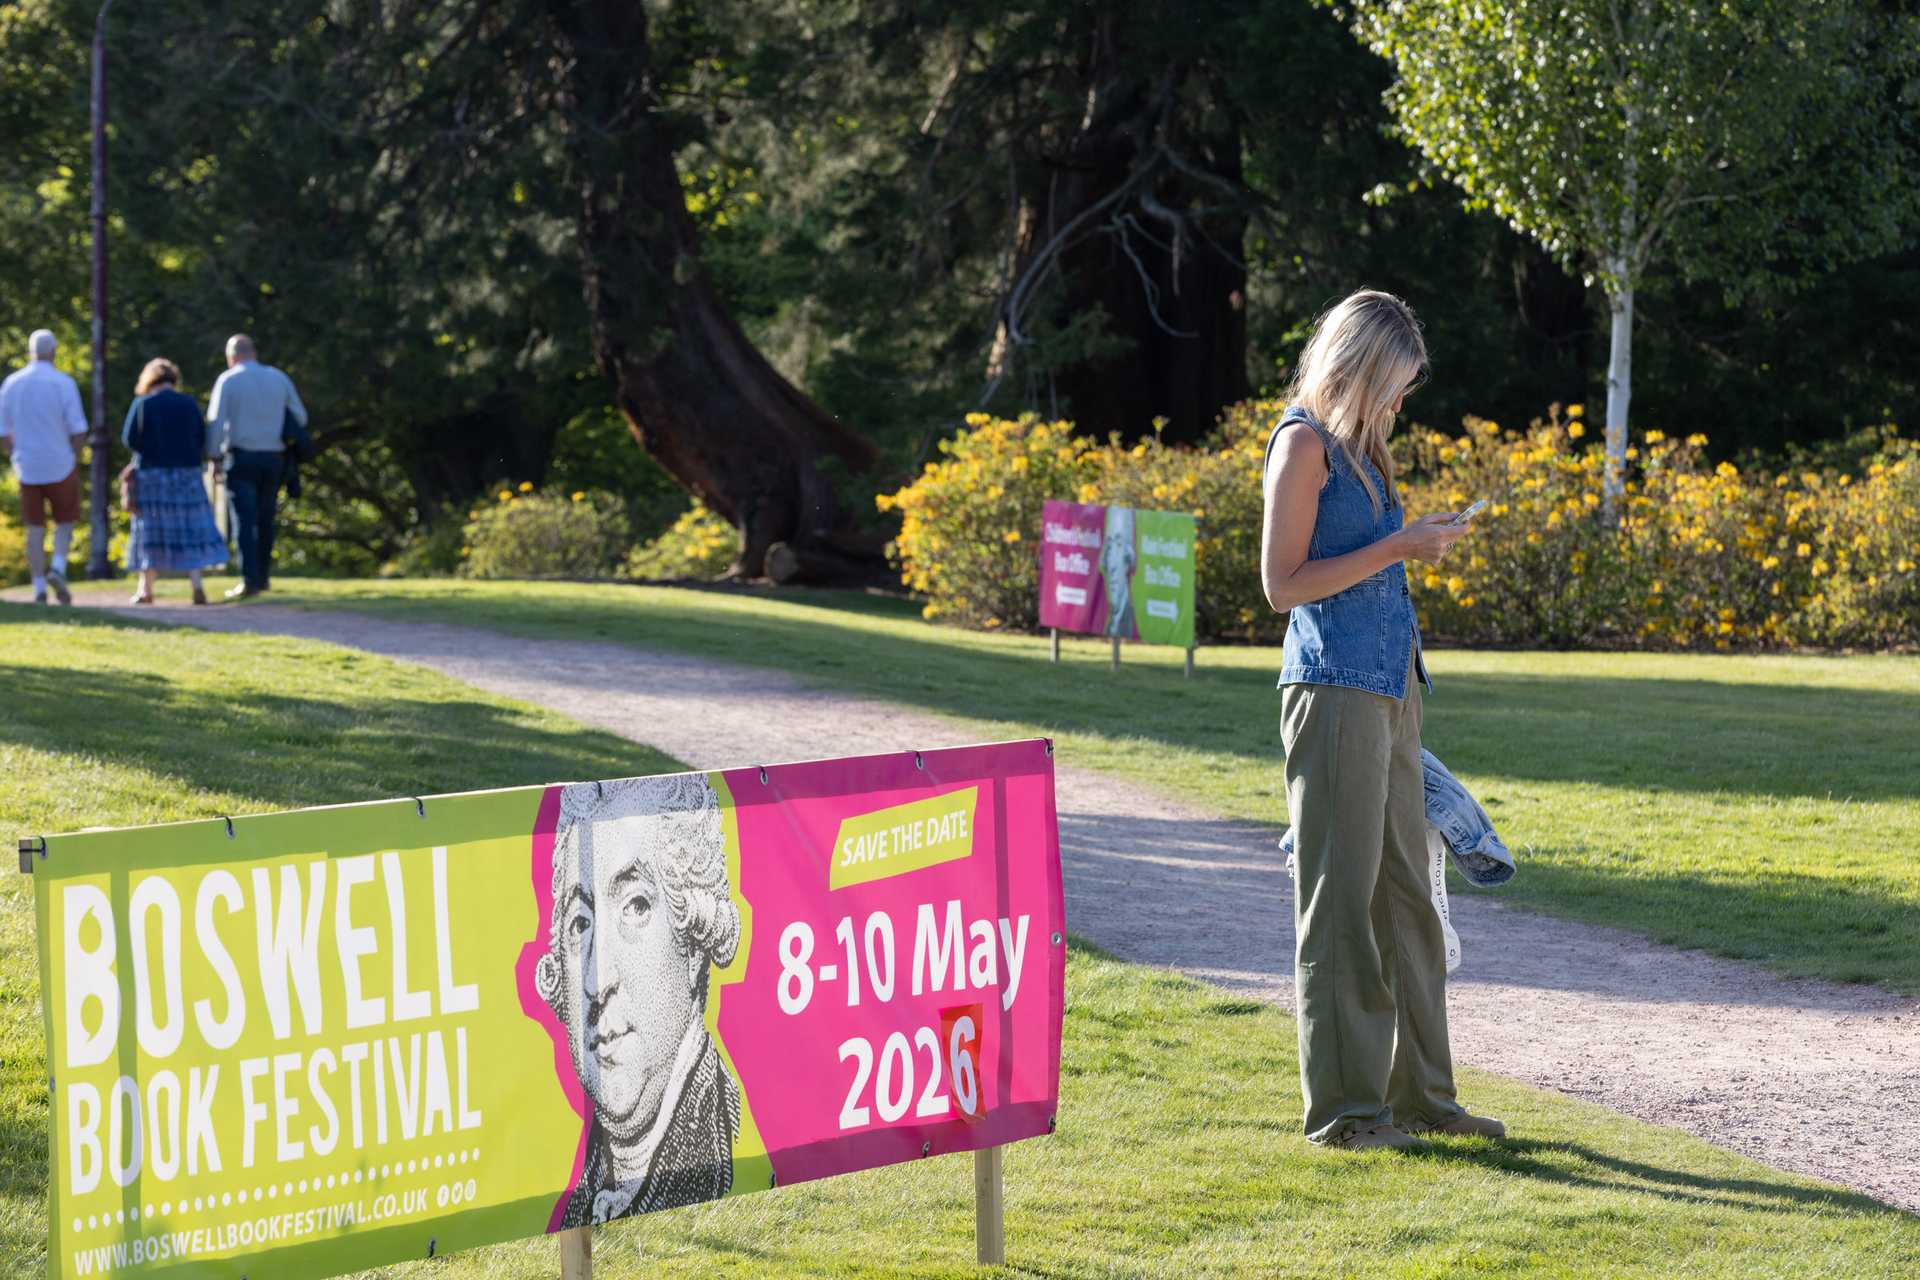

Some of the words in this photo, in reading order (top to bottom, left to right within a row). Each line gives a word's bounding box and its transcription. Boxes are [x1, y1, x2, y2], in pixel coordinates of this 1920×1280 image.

[840, 830, 888, 867] SAVE
[890, 820, 923, 855] THE
[926, 810, 968, 846] DATE
[63, 846, 480, 1068] BOSWELL
[777, 910, 895, 1016] 8-10
[911, 899, 1031, 1012] May
[67, 1063, 223, 1195] BOOK
[240, 1026, 482, 1168] FESTIVAL
[838, 1015, 979, 1131] 2026
[74, 1187, 428, 1277] WWW.BOSWELLBOOKFESTIVAL.CO.UK
